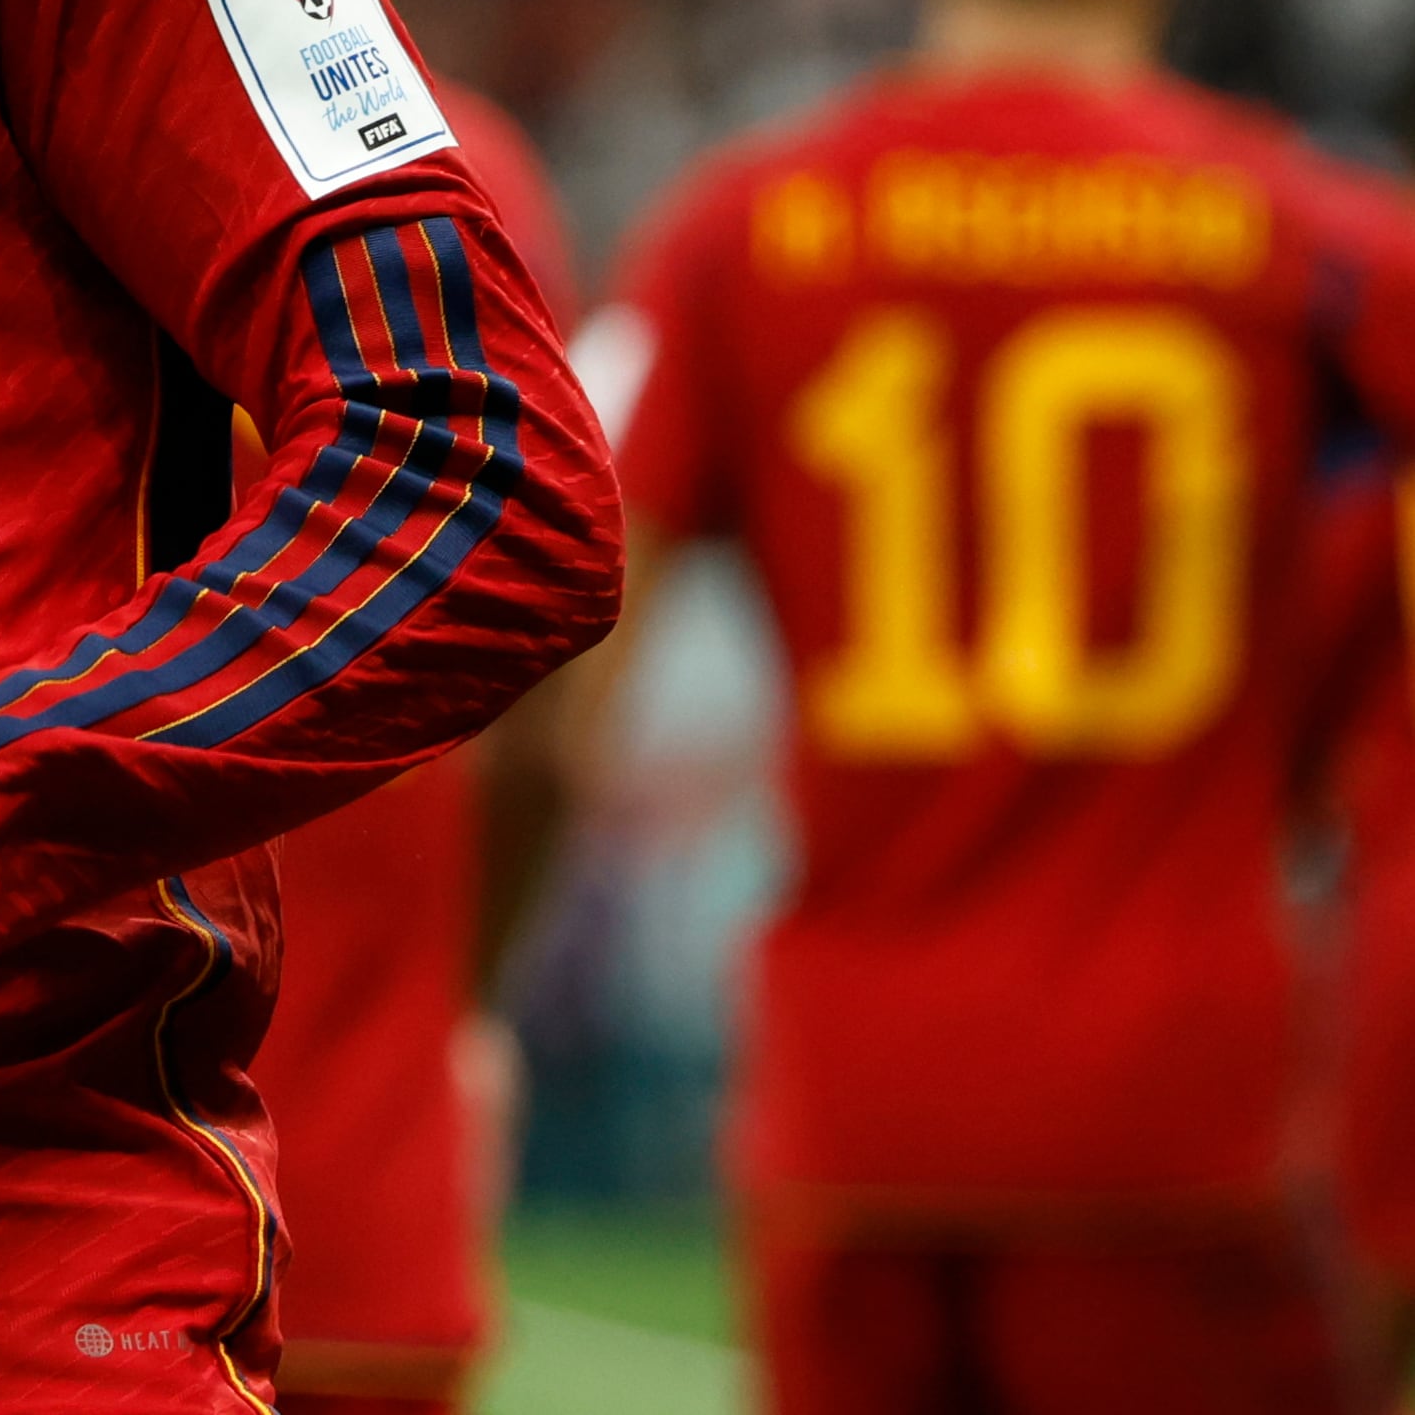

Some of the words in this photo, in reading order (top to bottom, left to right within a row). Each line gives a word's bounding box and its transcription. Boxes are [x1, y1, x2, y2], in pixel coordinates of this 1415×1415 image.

[299, 24, 374, 70] FOOTBALL
[310, 46, 390, 102] UNITES
[322, 100, 357, 132] the
[356, 75, 408, 116] World
[363, 116, 402, 147] FIFA
[789, 306, 1250, 764] 10
